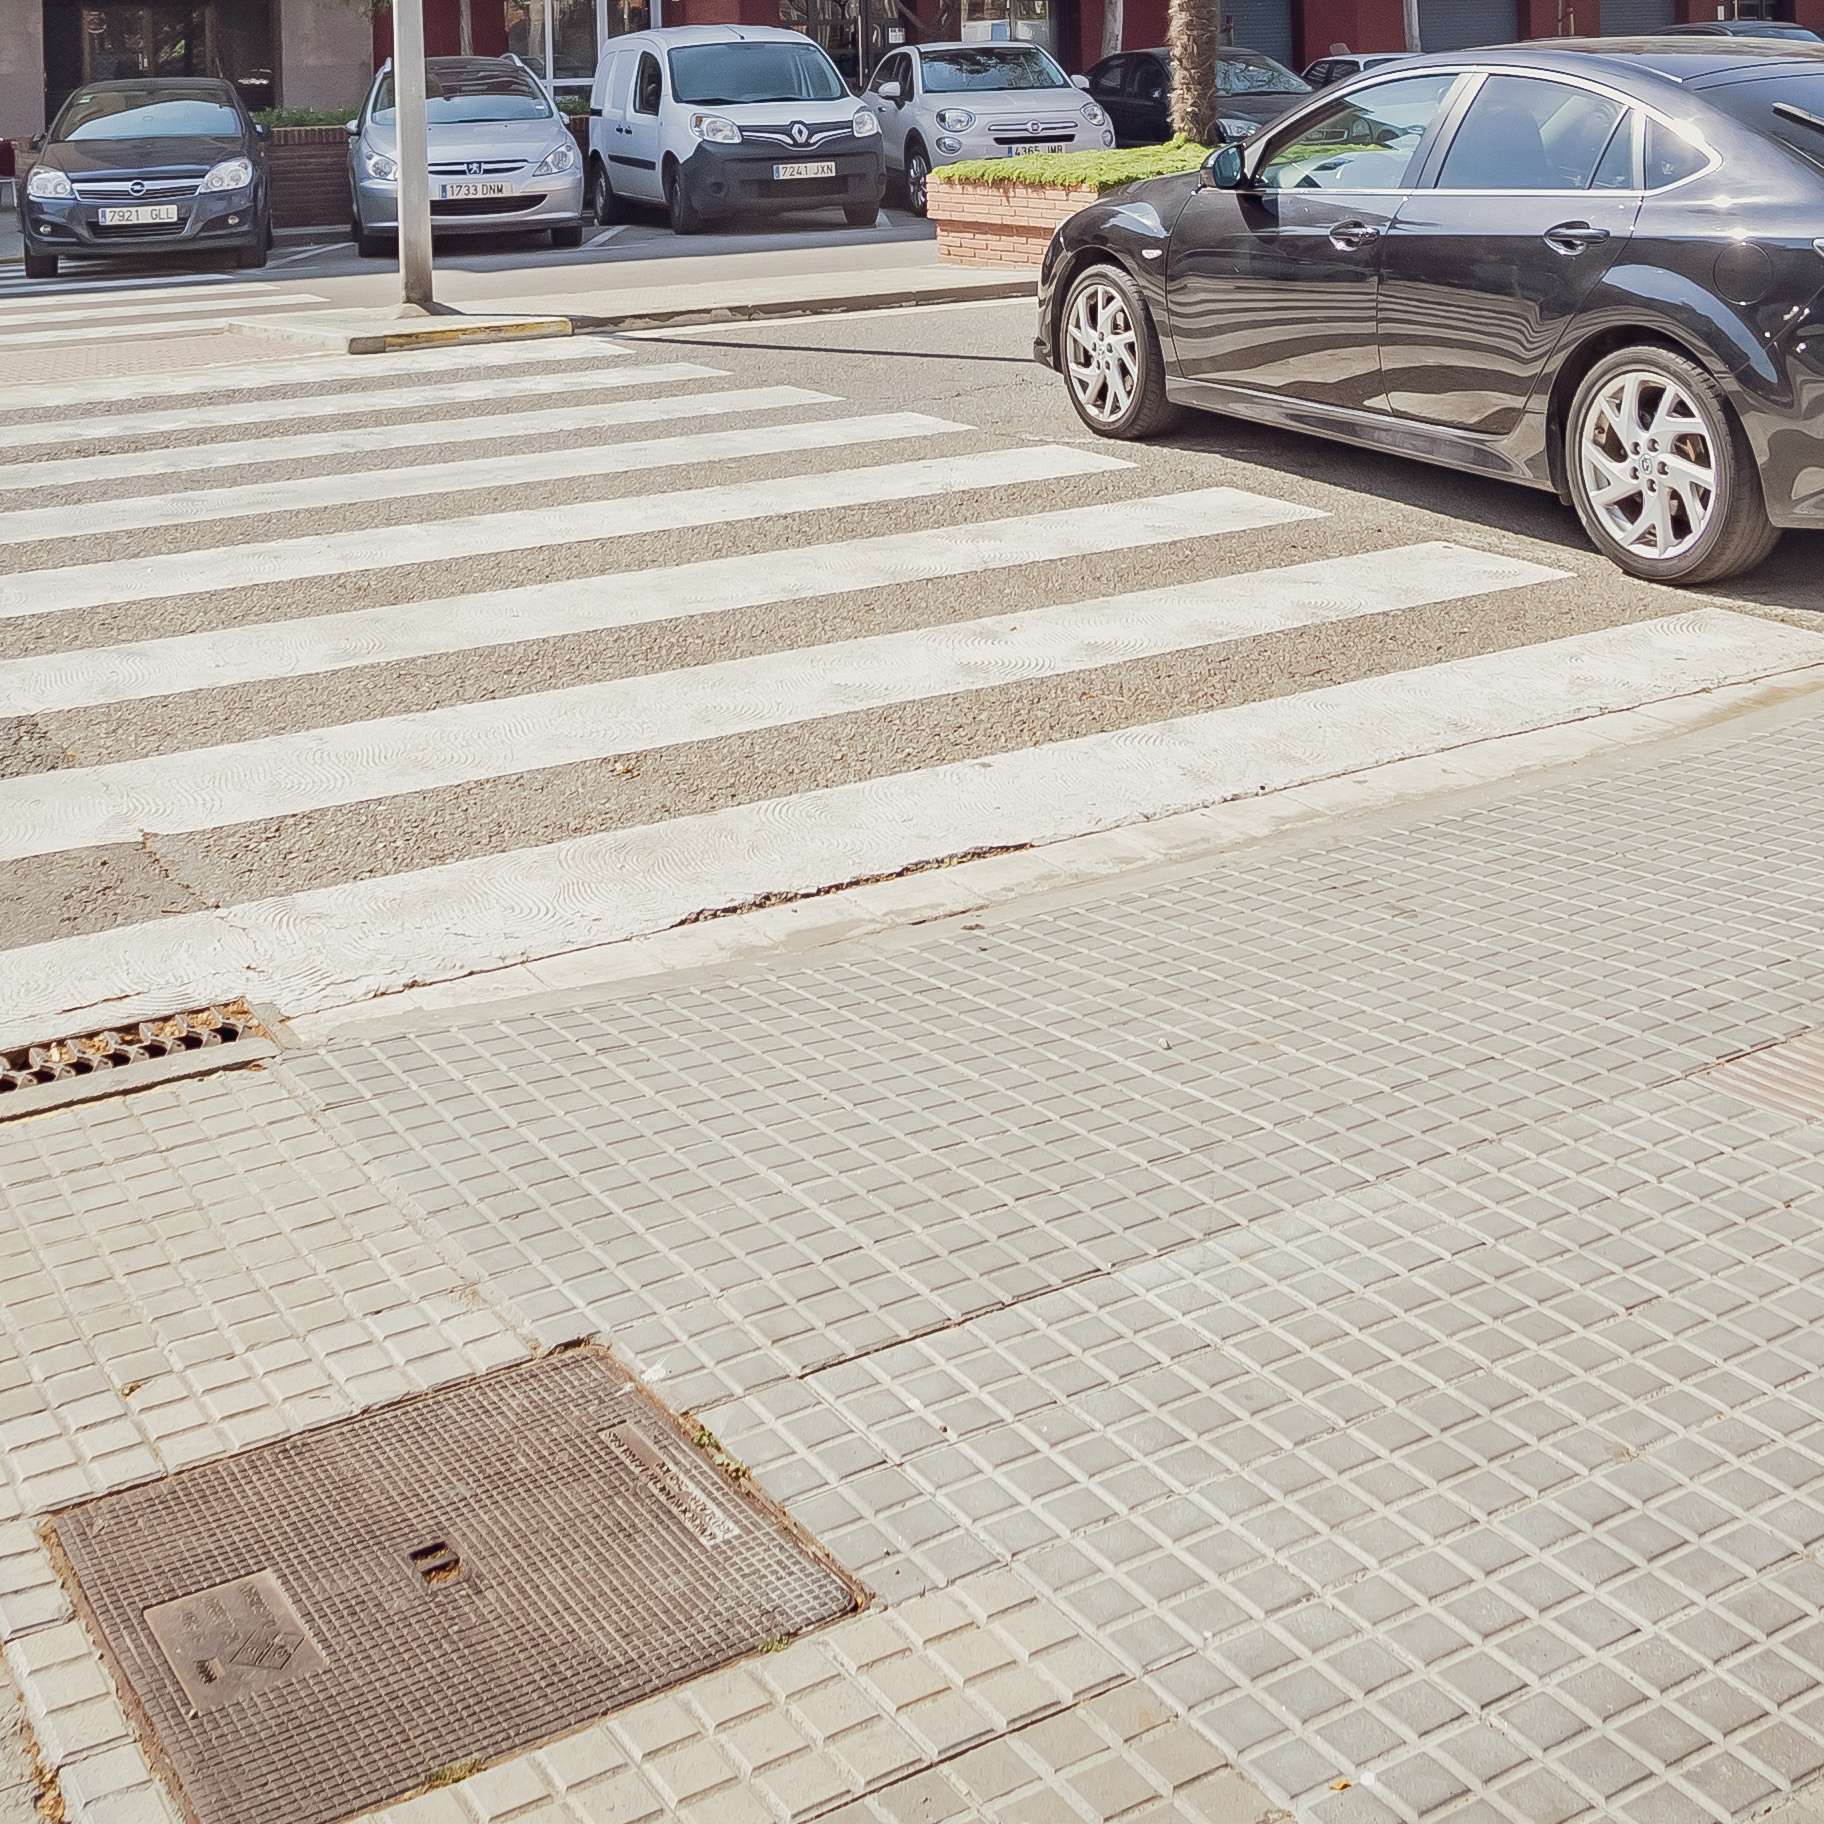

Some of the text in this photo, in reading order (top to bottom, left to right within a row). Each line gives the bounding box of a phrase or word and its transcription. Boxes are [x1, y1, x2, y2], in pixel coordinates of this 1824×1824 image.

[781, 164, 834, 177] 7241 JXN
[449, 184, 505, 197] 1733 DNM
[108, 208, 174, 223] 7921 GLL
